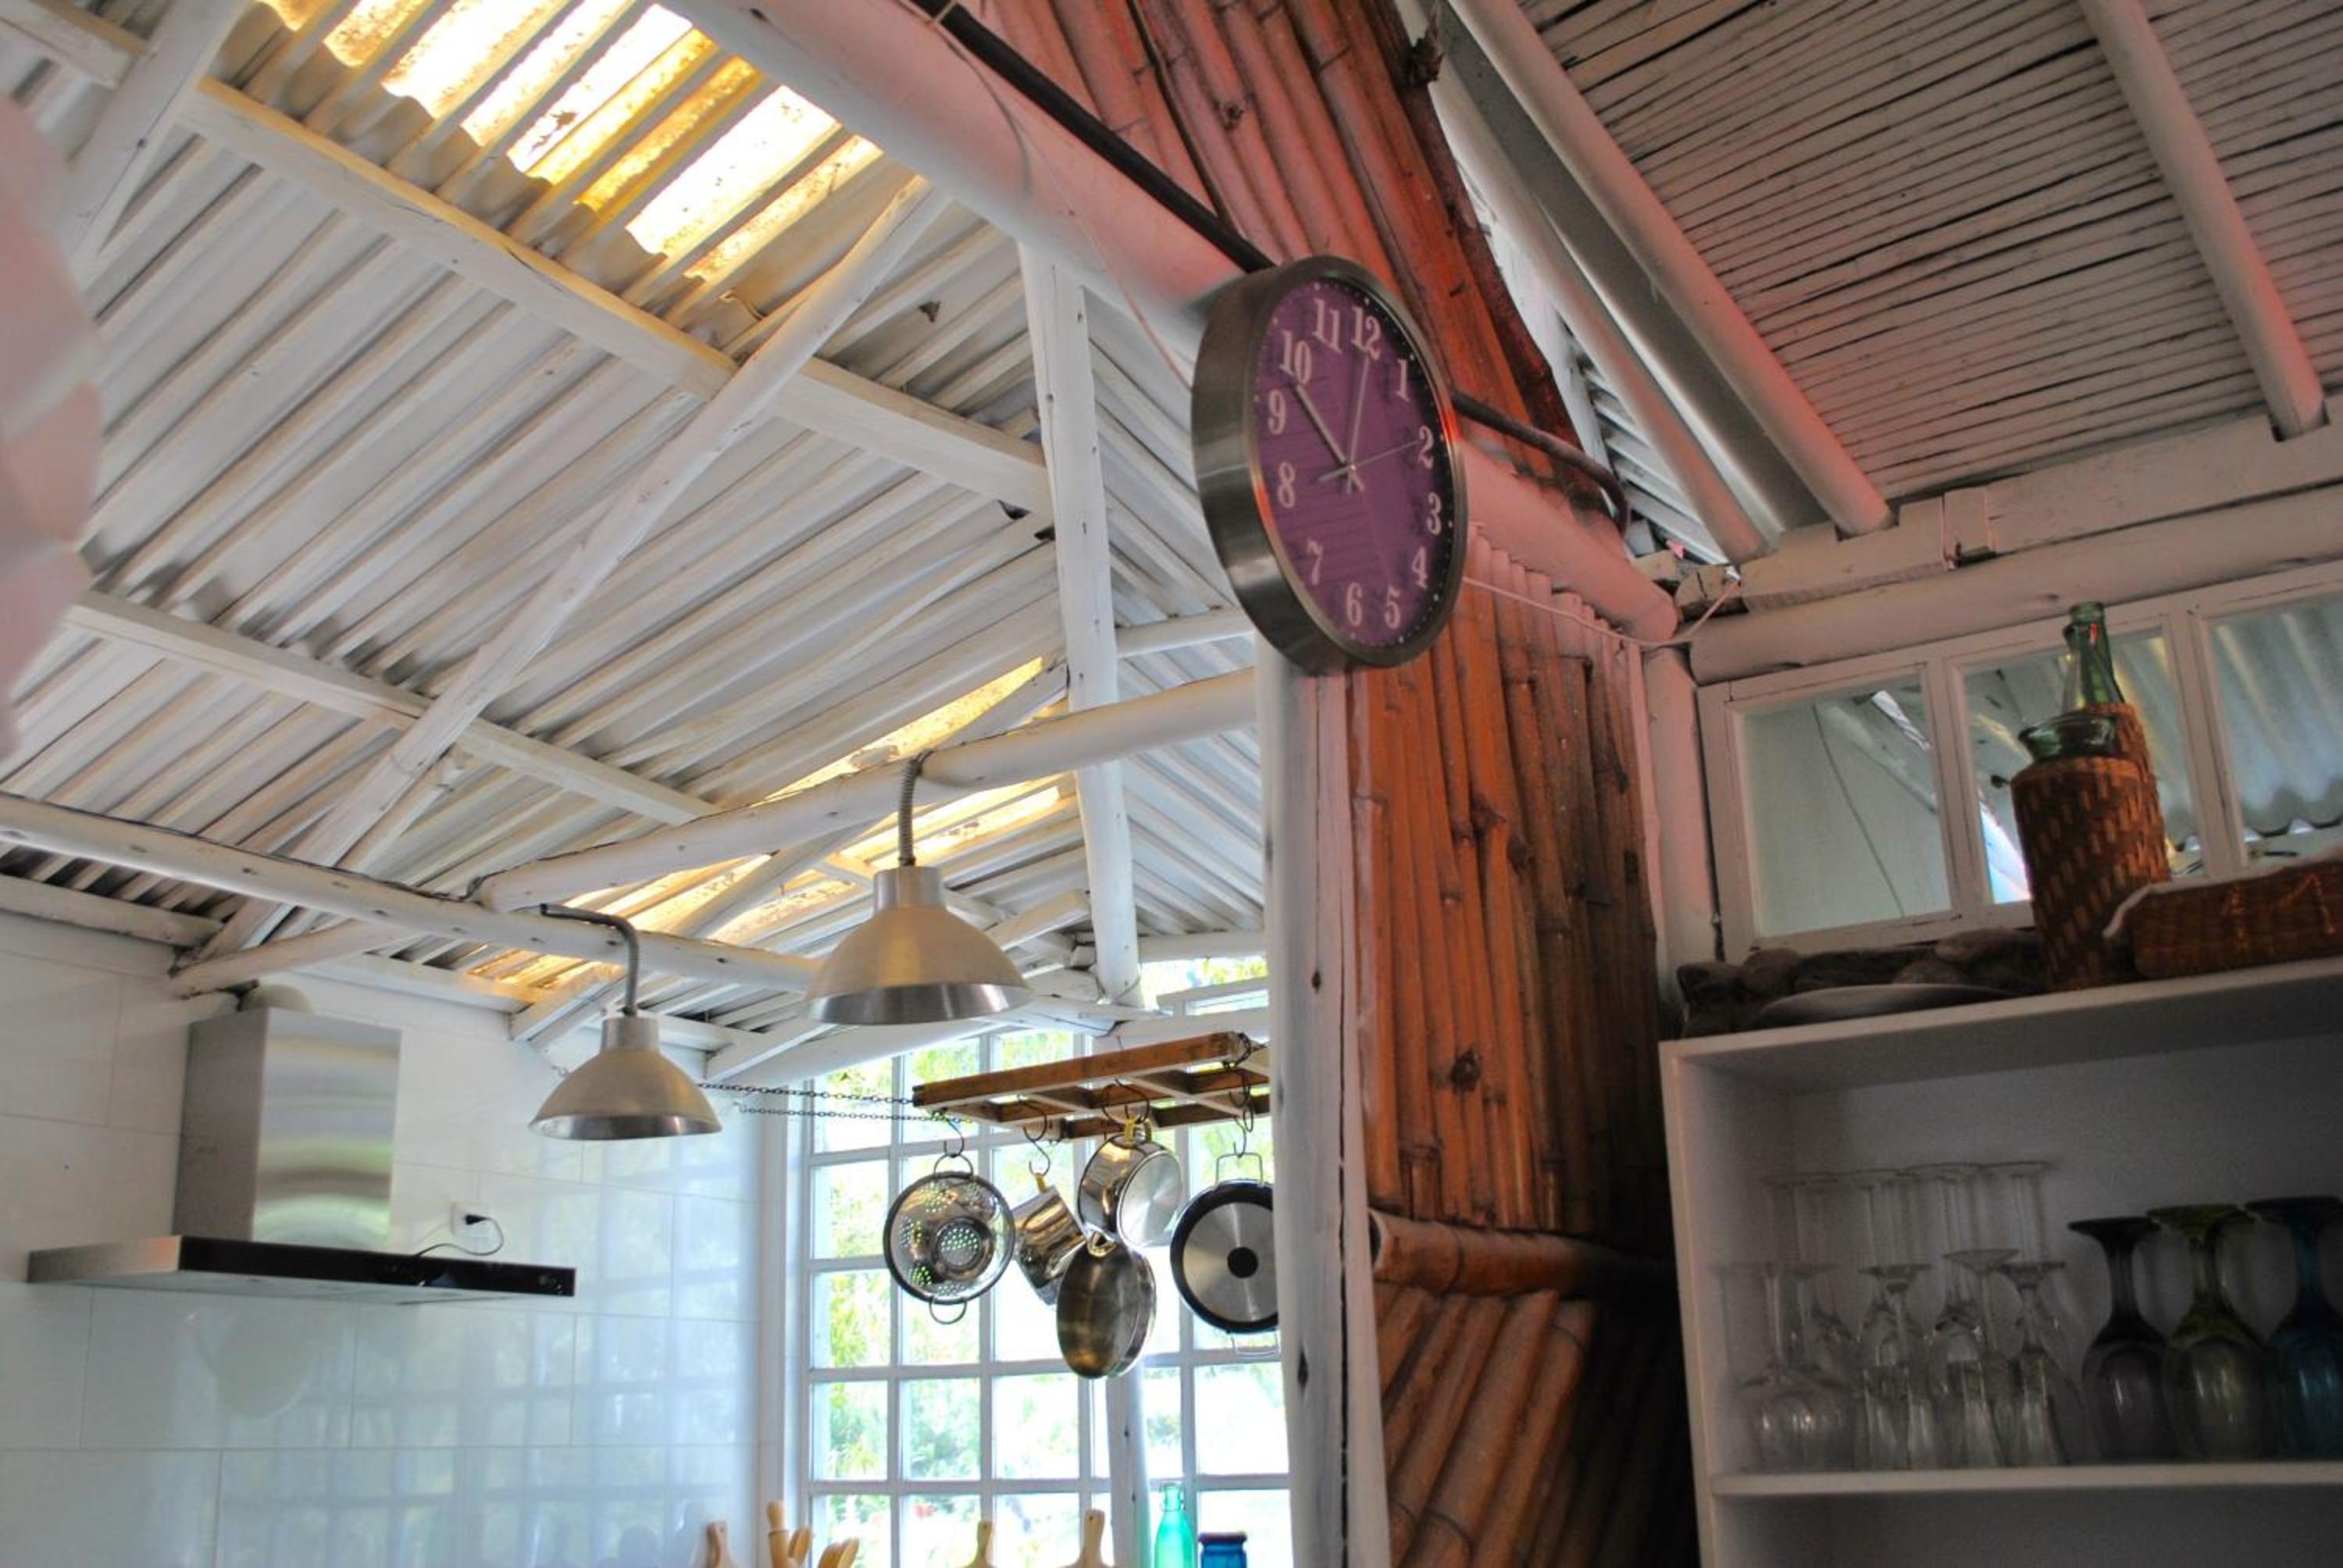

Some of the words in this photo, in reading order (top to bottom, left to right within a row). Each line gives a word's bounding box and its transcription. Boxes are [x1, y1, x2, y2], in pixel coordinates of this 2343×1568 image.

[1314, 298, 1342, 354] 11
[1351, 306, 1381, 361] 12
[1279, 329, 1312, 386] 10
[1396, 358, 1409, 401] 1
[1268, 390, 1287, 434] 9
[1418, 426, 1435, 467] 2
[1278, 462, 1296, 508] 8
[1427, 493, 1442, 536] 3
[1307, 538, 1323, 585] 7
[1412, 547, 1428, 589] 4
[1346, 583, 1362, 626] 6
[1385, 587, 1401, 629] 5
